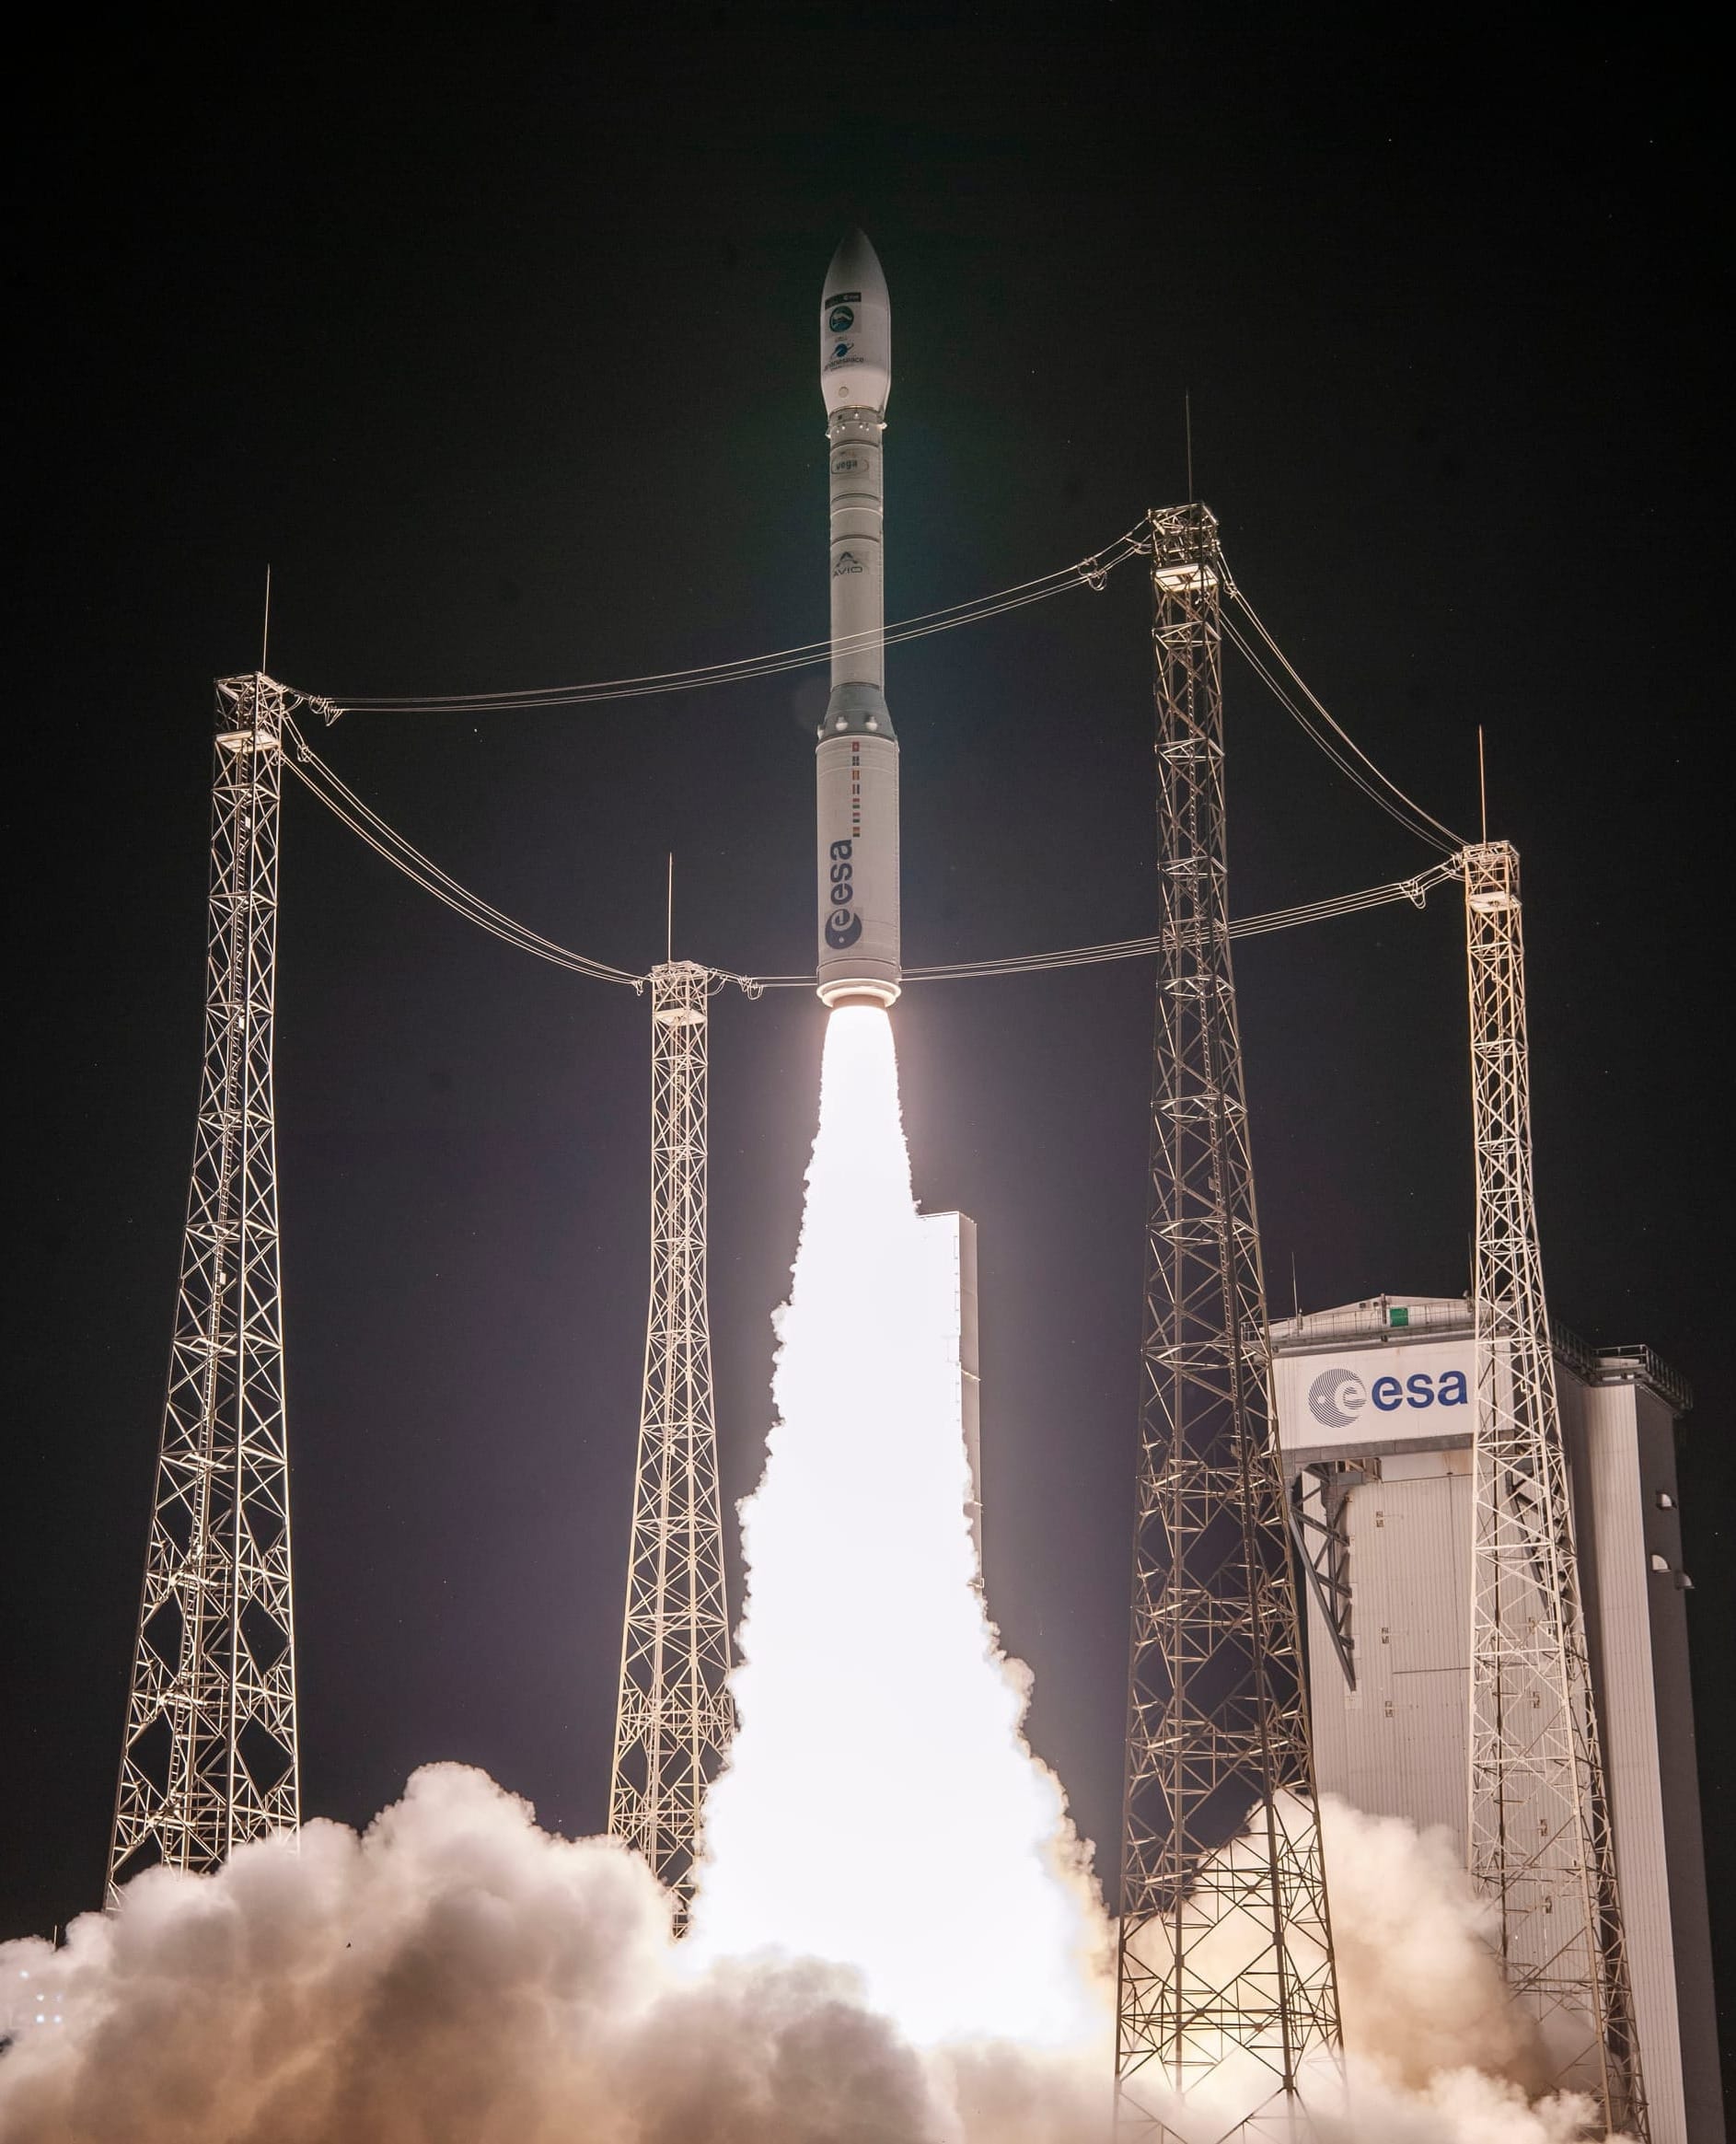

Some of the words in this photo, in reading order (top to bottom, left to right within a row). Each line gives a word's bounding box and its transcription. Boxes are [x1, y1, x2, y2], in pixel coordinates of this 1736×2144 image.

[833, 566, 862, 578] AVIO
[830, 839, 852, 905] esa
[1371, 1369, 1468, 1412] esa
